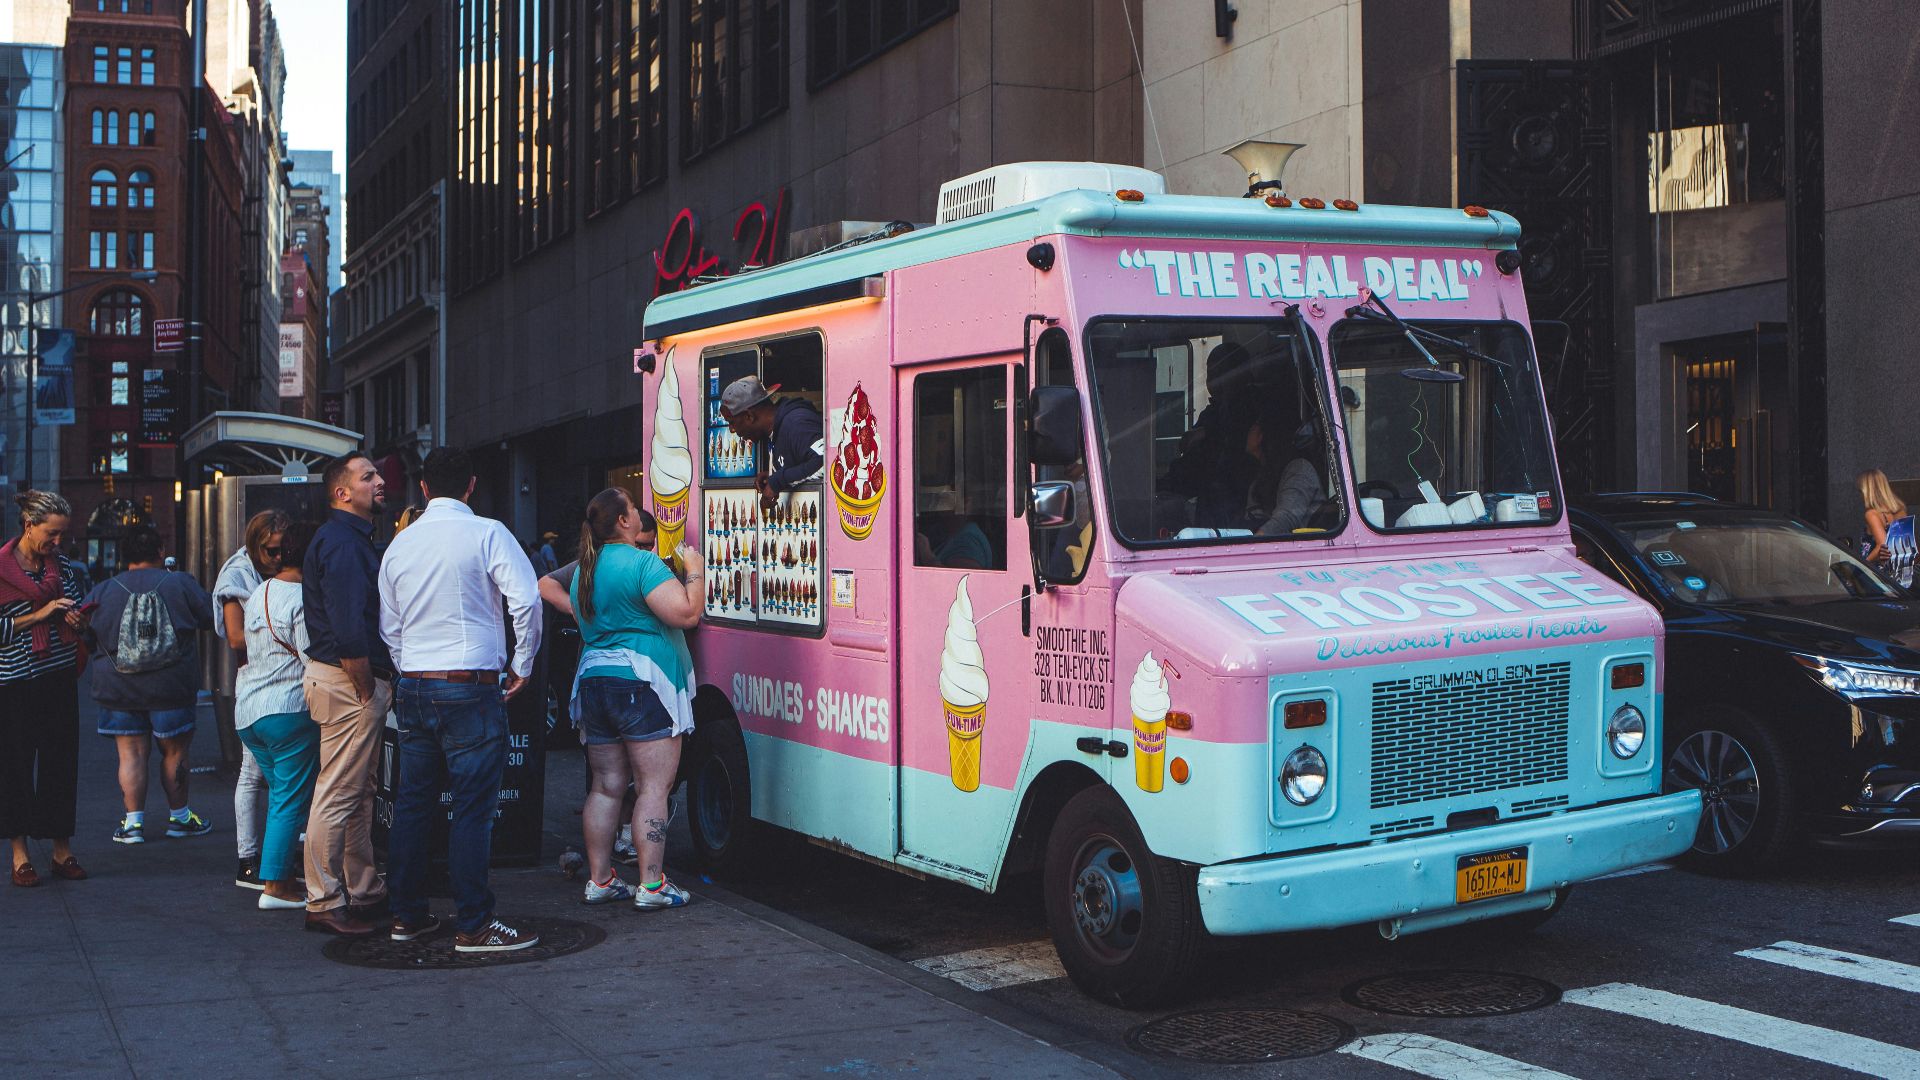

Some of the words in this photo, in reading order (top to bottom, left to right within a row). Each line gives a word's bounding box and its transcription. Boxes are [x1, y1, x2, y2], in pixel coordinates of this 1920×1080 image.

[1245, 253, 1360, 298] REAL
[165, 321, 185, 330] STAND
[656, 499, 687, 523] FUN-TIME
[1216, 571, 1630, 634] FROSTEE
[1036, 626, 1087, 654] SMOOTHIE
[1089, 630, 1109, 656] INC.
[1316, 632, 1441, 661] Delicious
[1441, 622, 1525, 649] Frostee
[1526, 615, 1608, 641] Treats
[1034, 652, 1050, 677] 328
[1098, 659, 1115, 684] ST.
[1413, 669, 1483, 691] GRUMMAN
[1486, 663, 1533, 682] OLSON
[732, 672, 804, 724] SUNDAES
[816, 687, 890, 744] SHAKES
[1040, 679, 1054, 704] BK.
[1057, 681, 1074, 706] N.Y.
[1077, 683, 1105, 711] 11206
[946, 710, 983, 733] FUN-TIME
[509, 734, 529, 748] ALE
[1134, 727, 1165, 743] FUN-TIME
[498, 789, 519, 800] ARDEN
[1475, 856, 1492, 864] NEW
[1473, 887, 1512, 899] COMMERCIAL
